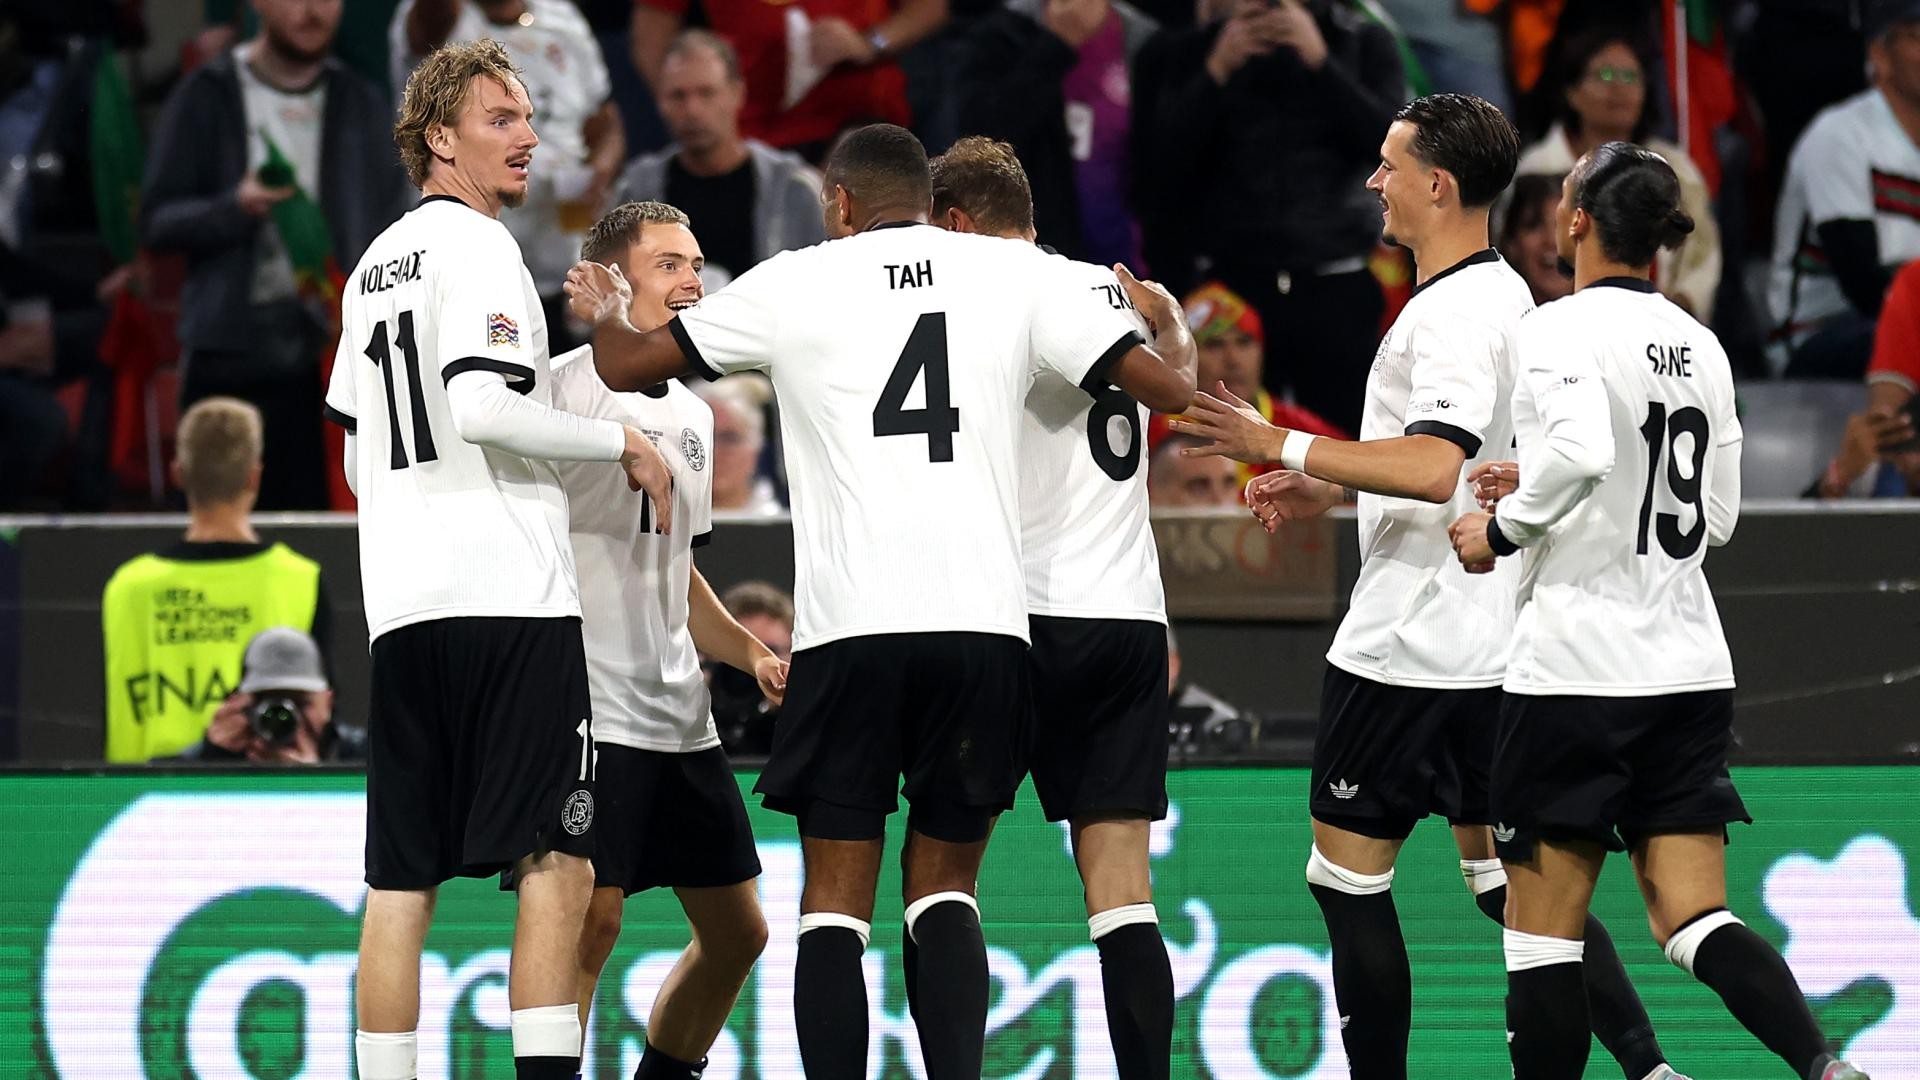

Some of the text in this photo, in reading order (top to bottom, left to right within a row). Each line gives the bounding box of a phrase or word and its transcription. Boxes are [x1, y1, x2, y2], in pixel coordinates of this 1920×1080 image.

[883, 259, 933, 290] TAH
[1091, 284, 1135, 310] ZK
[364, 310, 438, 470] 11
[873, 312, 960, 463] 4
[1636, 400, 1708, 560] 19
